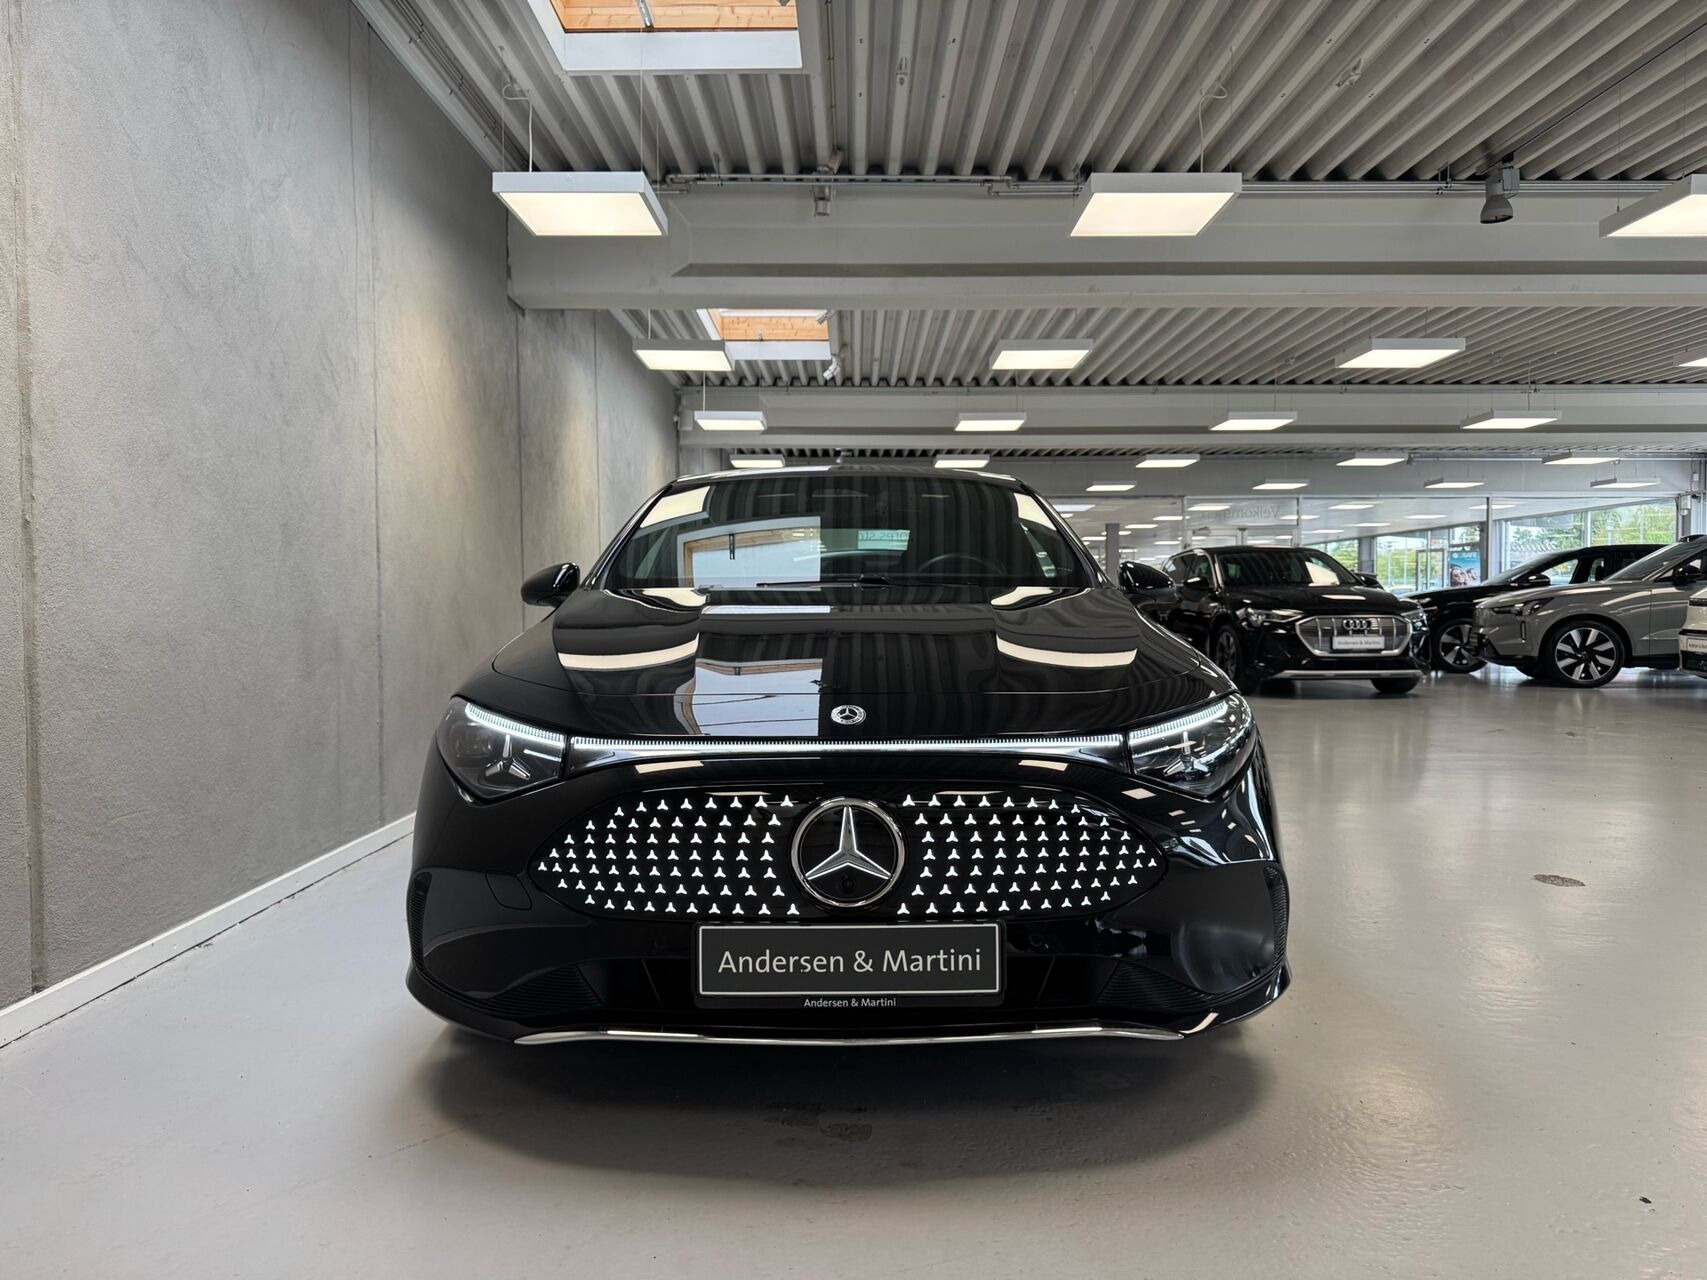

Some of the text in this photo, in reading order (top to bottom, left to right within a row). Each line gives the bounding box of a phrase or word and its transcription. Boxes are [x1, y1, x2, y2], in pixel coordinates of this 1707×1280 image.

[718, 948, 981, 973] Andersen & Martini
[804, 997, 897, 1008] Andersen & Martini
